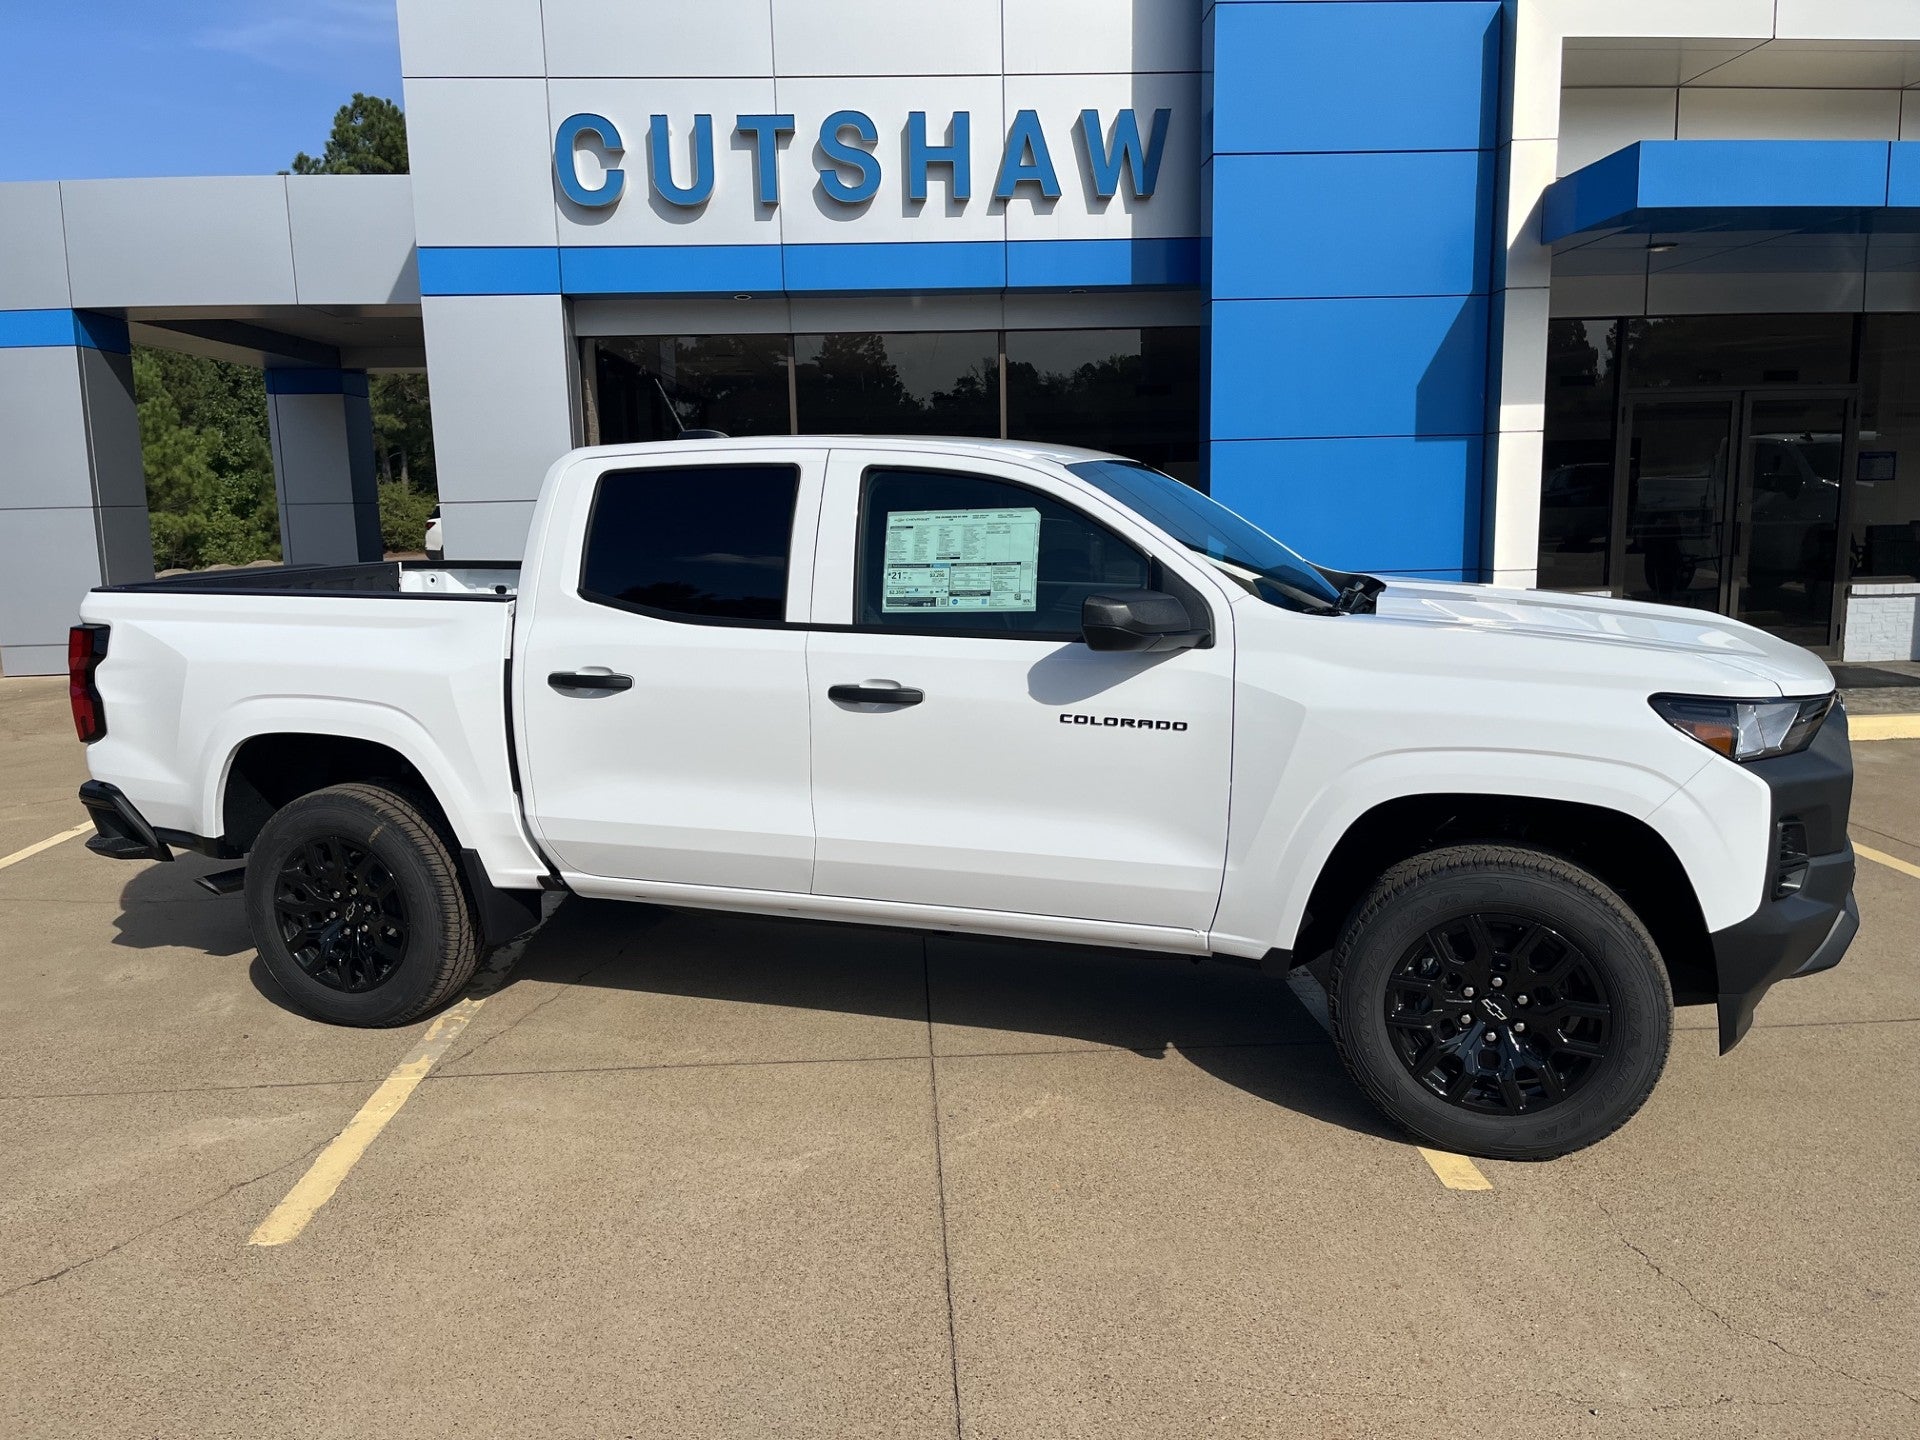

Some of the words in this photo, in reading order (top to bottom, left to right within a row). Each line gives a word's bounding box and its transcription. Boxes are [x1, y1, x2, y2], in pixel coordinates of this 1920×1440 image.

[554, 108, 1171, 207] CUTSHAW
[891, 571, 902, 580] 21
[1060, 714, 1188, 731] COLORADO
